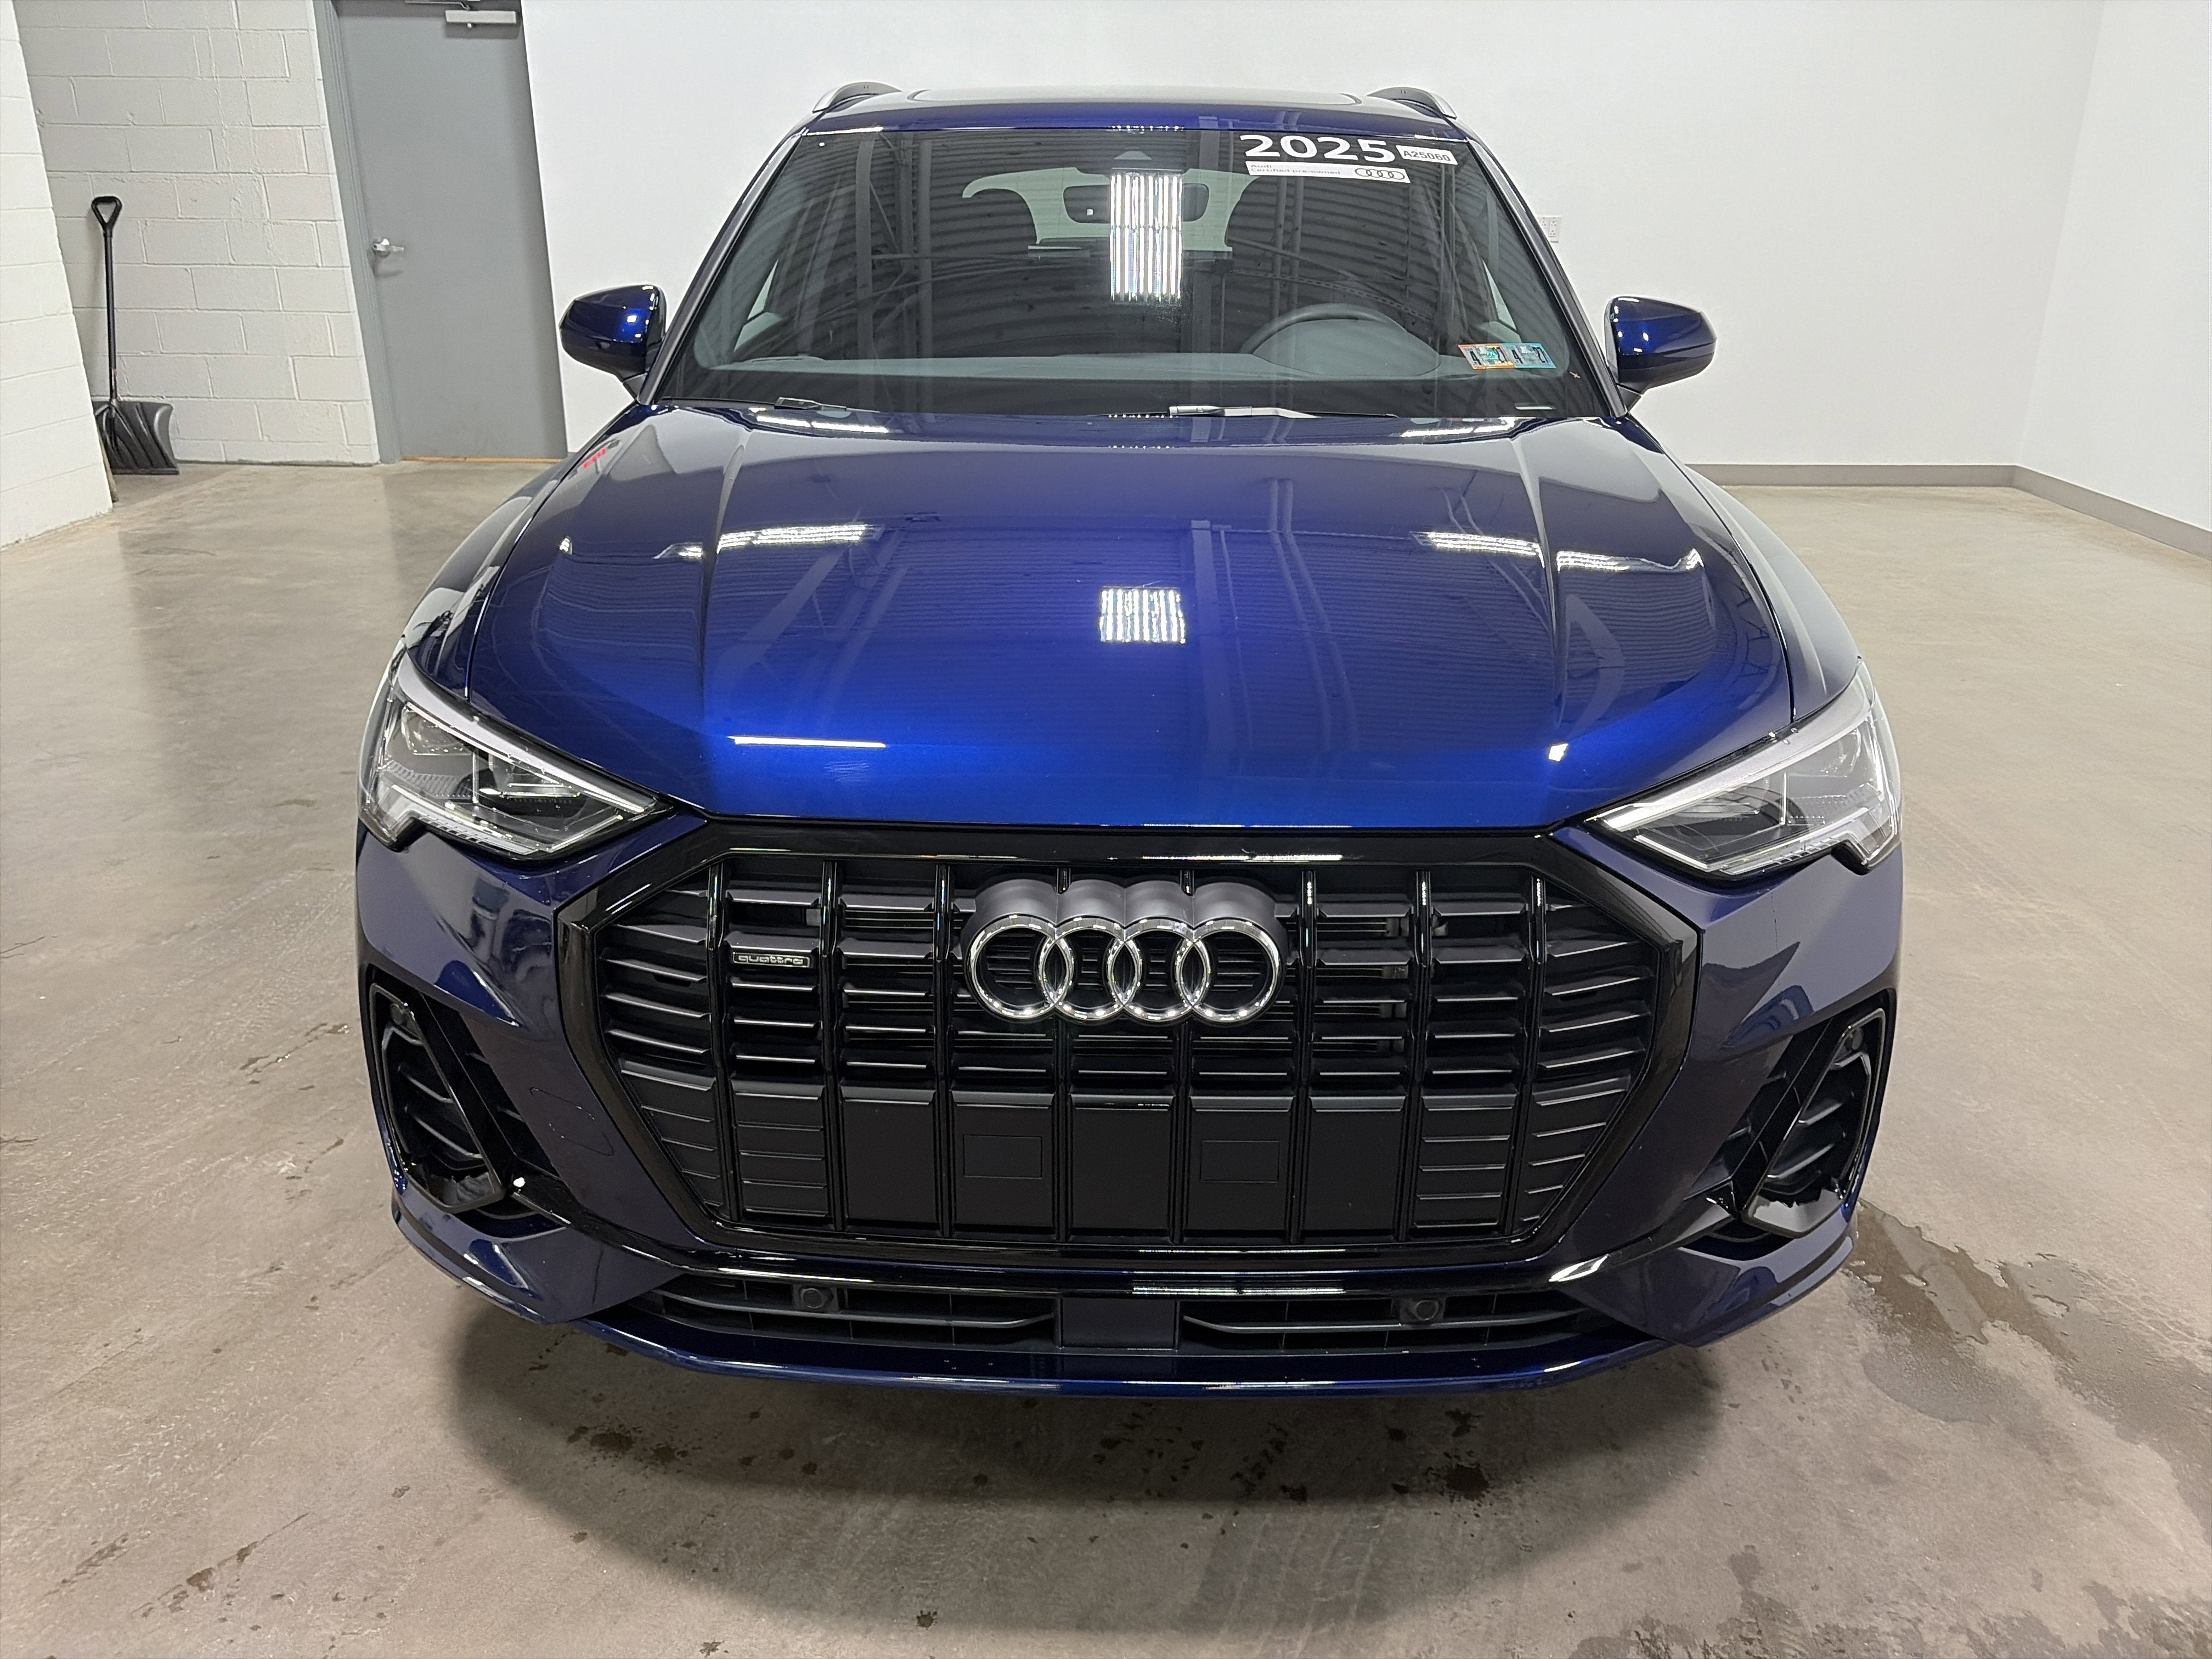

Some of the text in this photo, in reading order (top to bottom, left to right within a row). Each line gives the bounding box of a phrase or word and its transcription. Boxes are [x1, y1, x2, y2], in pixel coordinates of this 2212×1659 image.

[1240, 134, 1395, 163] 2025
[1403, 150, 1451, 161] A25060
[1470, 351, 1482, 365] 4
[1511, 349, 1523, 364] 4
[738, 955, 803, 965] quattro
